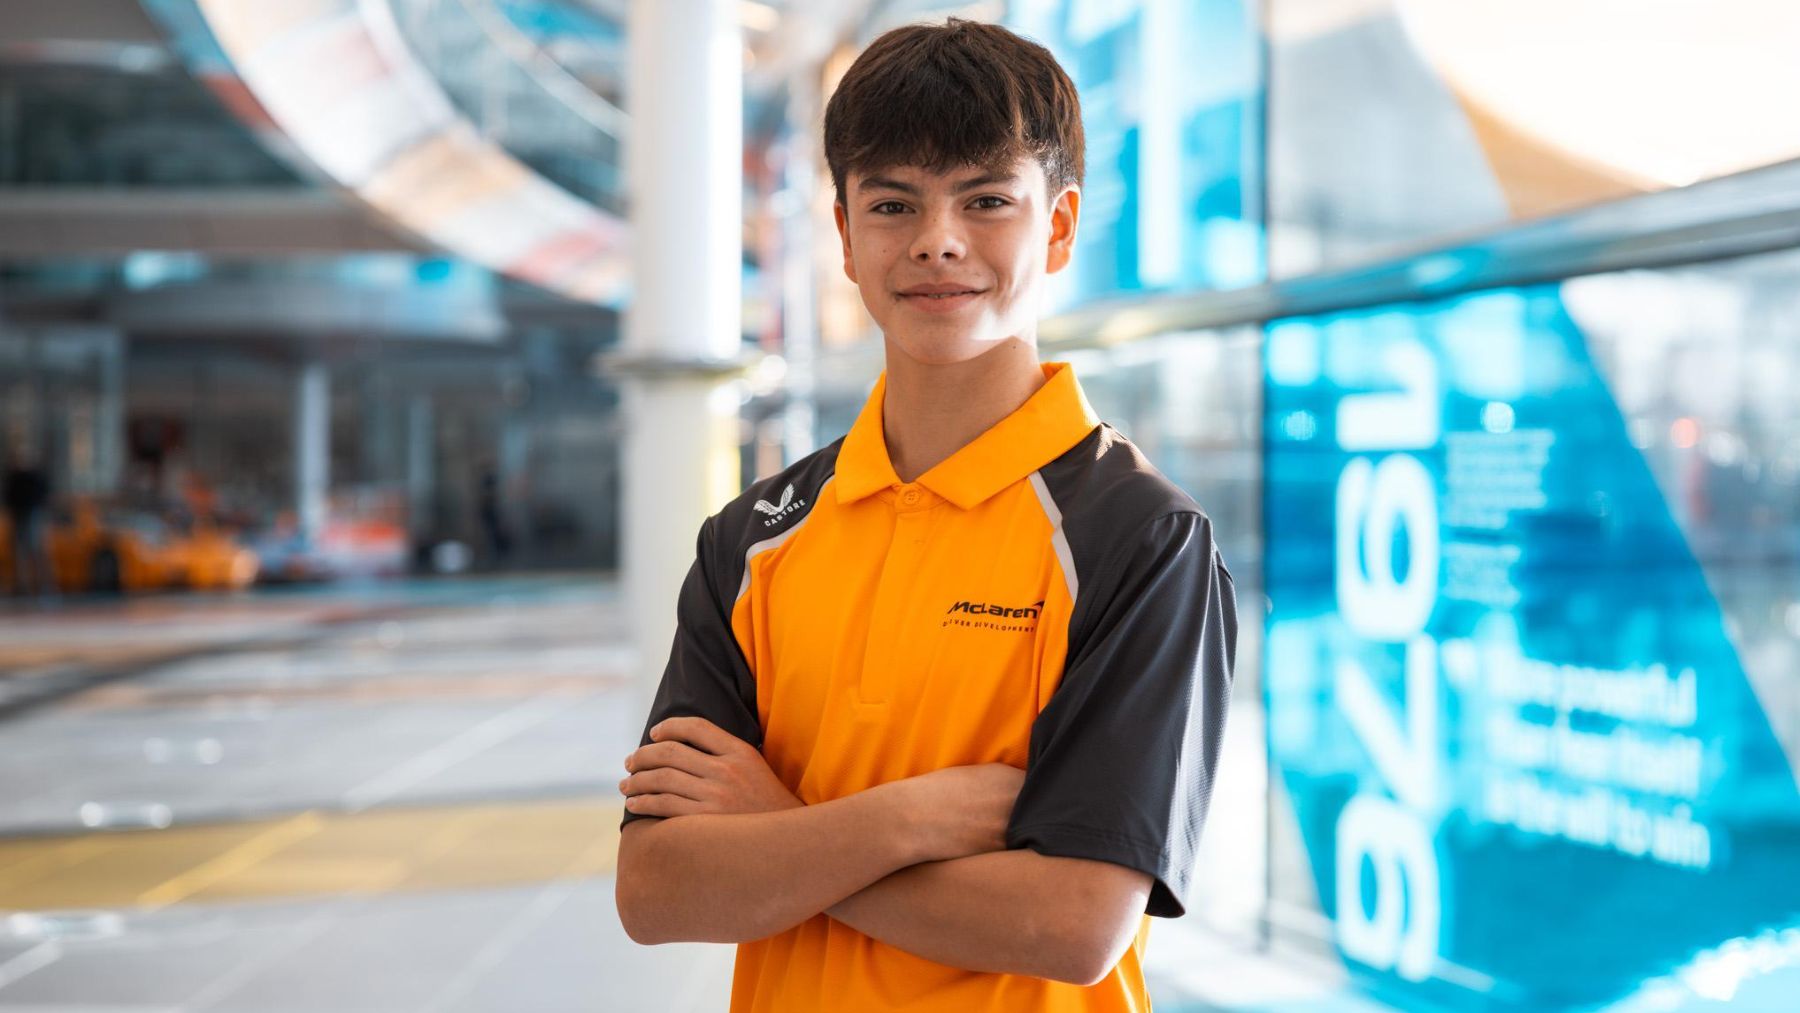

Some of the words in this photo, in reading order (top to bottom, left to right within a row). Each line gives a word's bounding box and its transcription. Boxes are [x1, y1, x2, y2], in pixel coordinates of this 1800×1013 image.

[764, 499, 806, 527] CASTORE
[947, 601, 1040, 619] McLaren
[942, 619, 971, 627] DIVER
[1336, 338, 1440, 983] 1976
